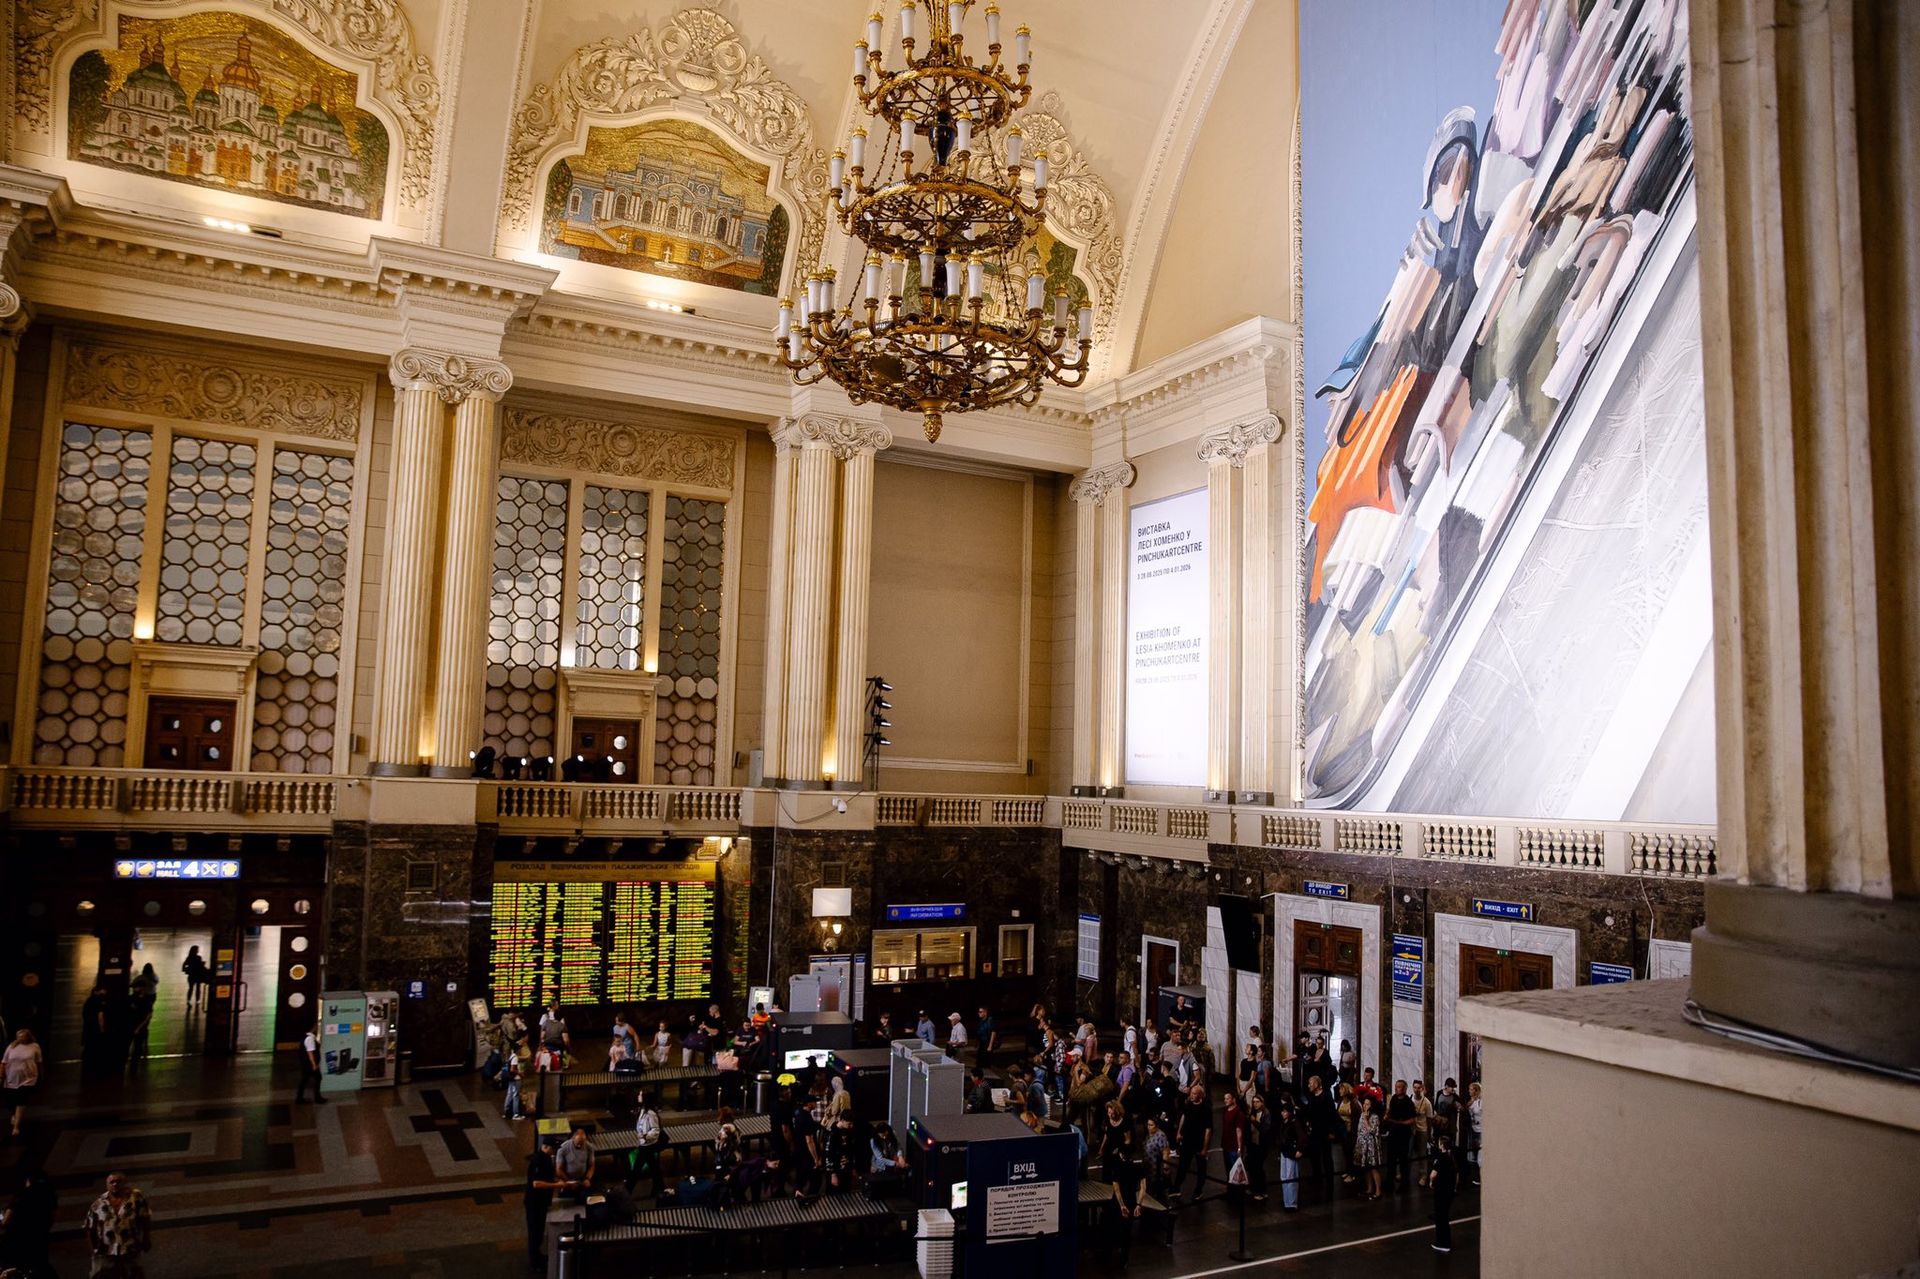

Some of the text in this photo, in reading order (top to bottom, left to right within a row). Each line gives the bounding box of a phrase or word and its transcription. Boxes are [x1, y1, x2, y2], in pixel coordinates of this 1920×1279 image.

[1137, 521, 1171, 537] ВИСТАВКА
[1137, 529, 1192, 551] ЛЕСІ ХОМЕНКО У
[1137, 541, 1203, 564] PINCHUKARTCENTRE
[1136, 626, 1182, 641] EXHIBITION OF
[1135, 637, 1201, 655] LESIA KHOMENKO AT
[1135, 652, 1201, 669] PINCHUKARTCENTRE
[183, 861, 200, 877] 4
[1013, 1162, 1036, 1173] ВХІД
